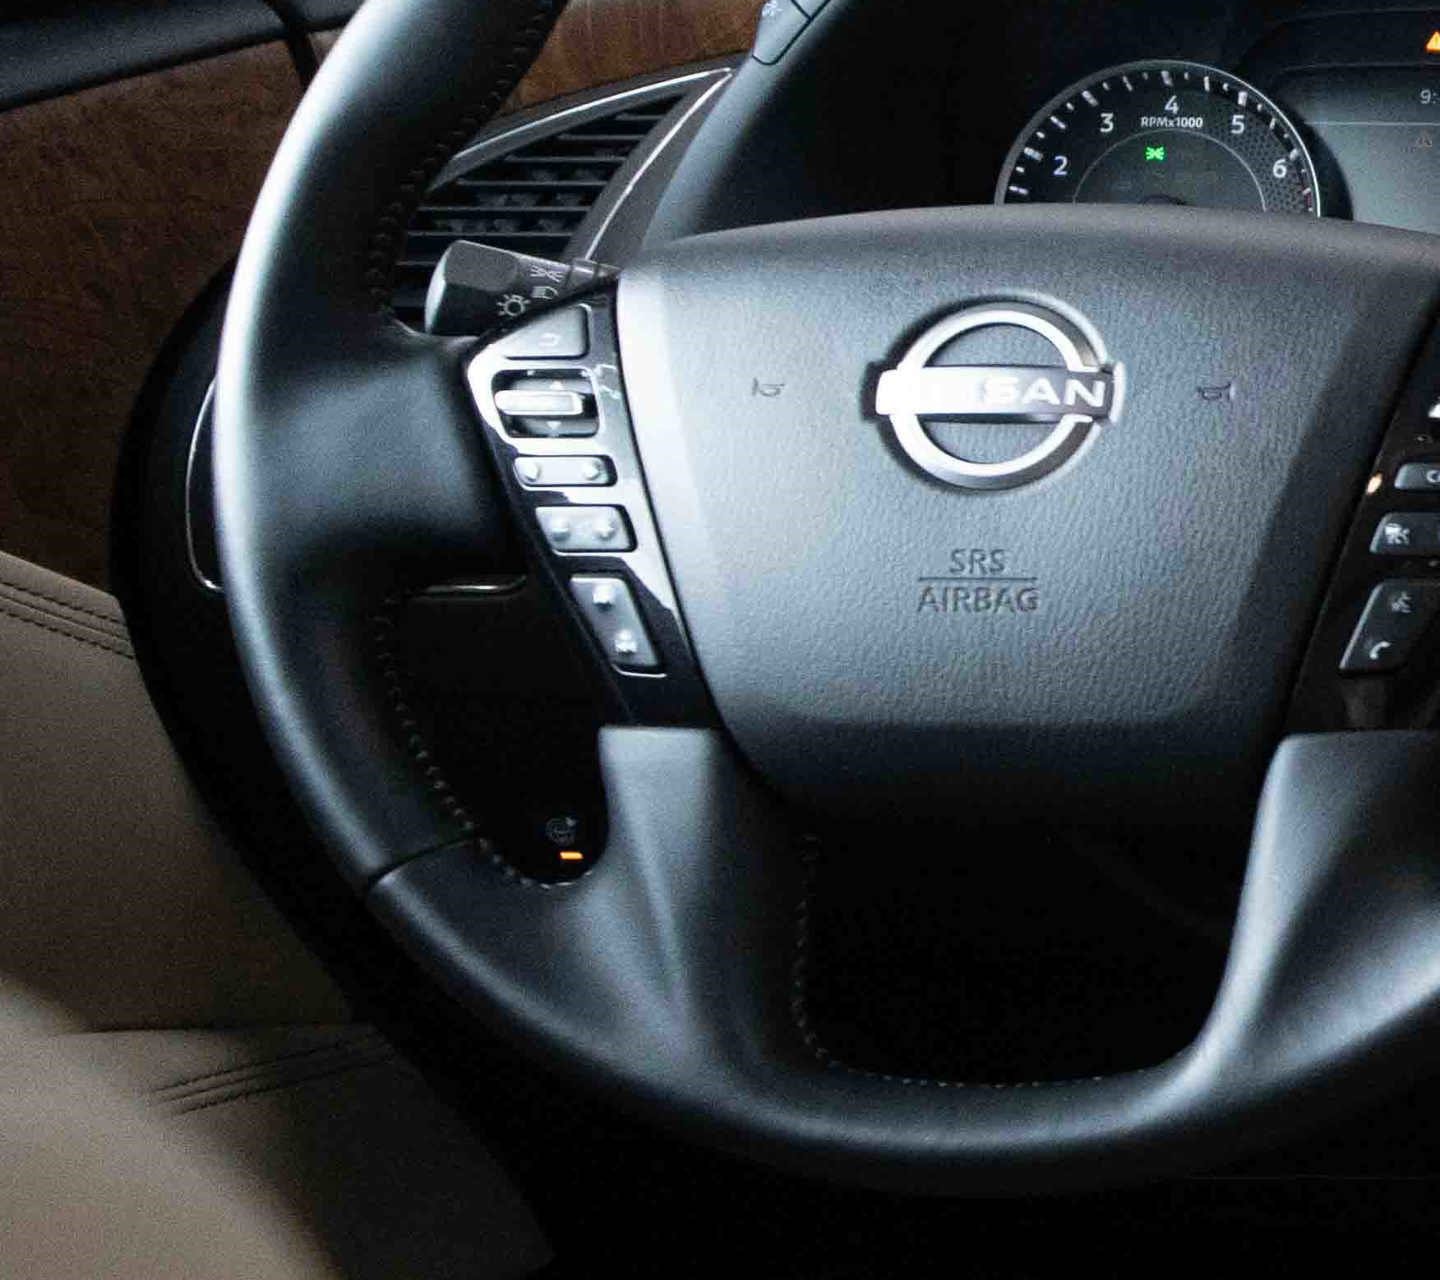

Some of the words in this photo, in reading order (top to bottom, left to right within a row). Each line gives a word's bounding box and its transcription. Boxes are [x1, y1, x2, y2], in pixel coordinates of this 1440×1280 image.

[1165, 95, 1179, 115] 4
[1100, 112, 1114, 132] 3
[1231, 114, 1245, 134] 5
[1053, 155, 1069, 176] 2
[1273, 158, 1287, 178] 6
[950, 549, 1006, 575] SRS
[917, 586, 1039, 614] AIRBAG
